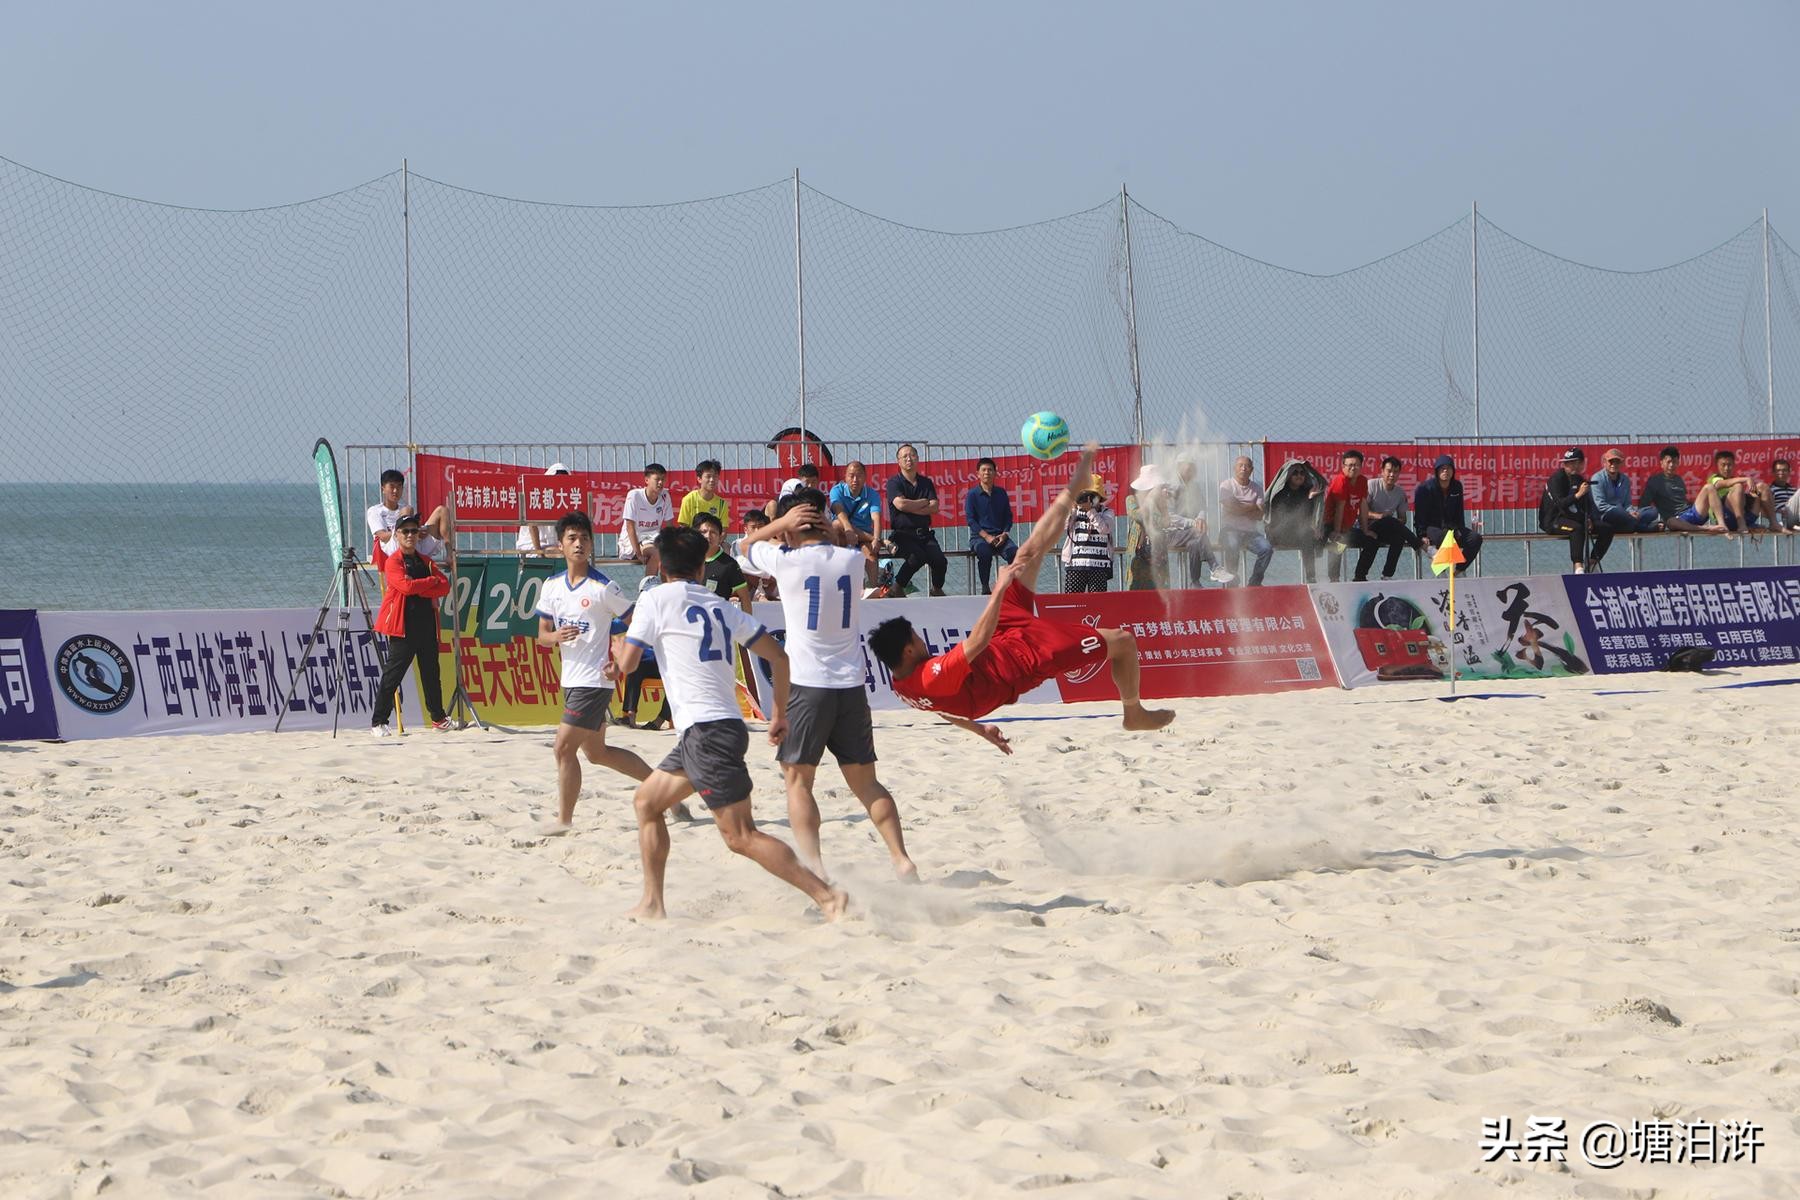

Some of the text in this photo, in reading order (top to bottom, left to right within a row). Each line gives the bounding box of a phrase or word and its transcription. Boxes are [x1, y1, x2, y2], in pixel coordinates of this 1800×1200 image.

[457, 486, 517, 508] 北海市第九中学
[530, 487, 582, 509] 成都大学
[487, 583, 511, 630] 2
[517, 576, 542, 620] 0
[804, 575, 851, 630] 11
[687, 606, 732, 665] 21
[0, 638, 35, 714] 司
[133, 631, 403, 720] 广西中体海蓝水上运动俱乐
